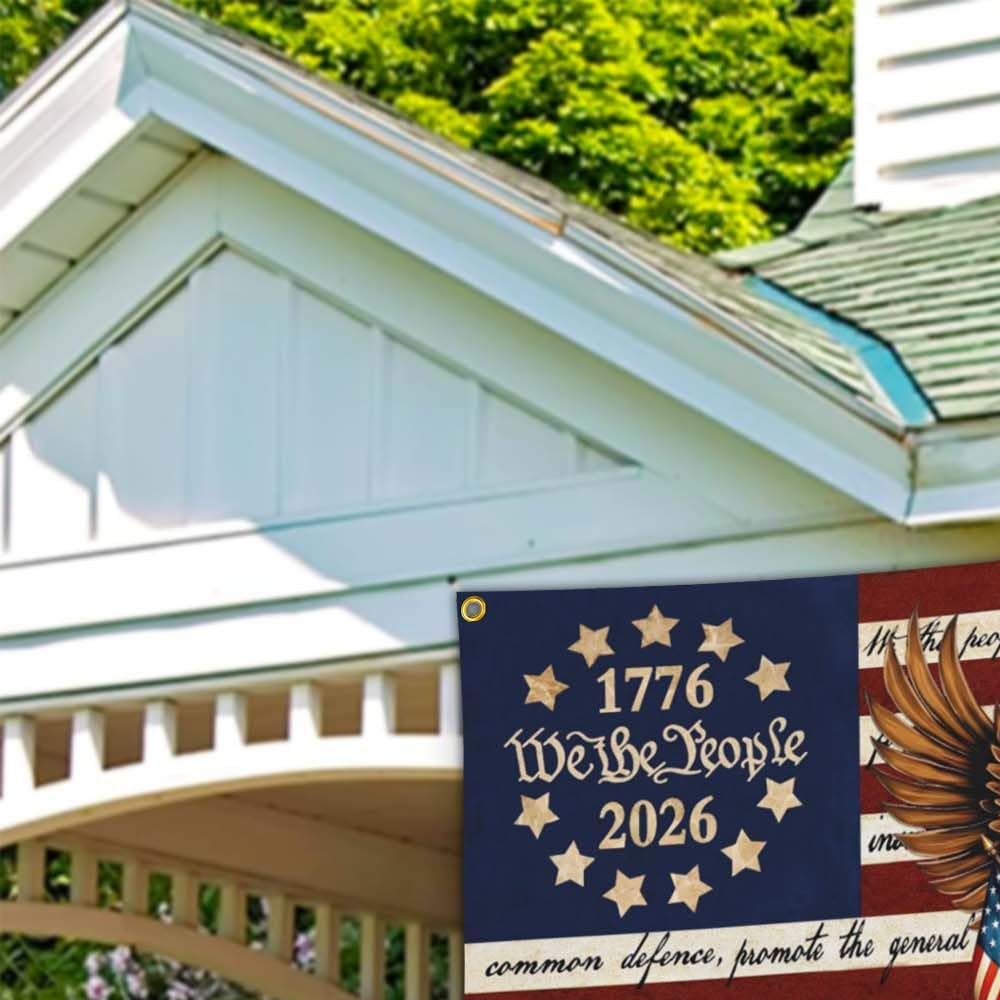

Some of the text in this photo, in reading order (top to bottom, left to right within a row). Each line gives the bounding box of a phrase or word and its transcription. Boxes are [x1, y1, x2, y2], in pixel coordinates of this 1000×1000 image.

[596, 663, 714, 714] 1776
[503, 727, 595, 783] We
[653, 716, 808, 784] People
[598, 795, 719, 850] 2026
[485, 954, 603, 977] common
[620, 932, 723, 990] defence,
[727, 922, 829, 988] promote
[839, 919, 875, 959] the
[880, 912, 977, 985] general
